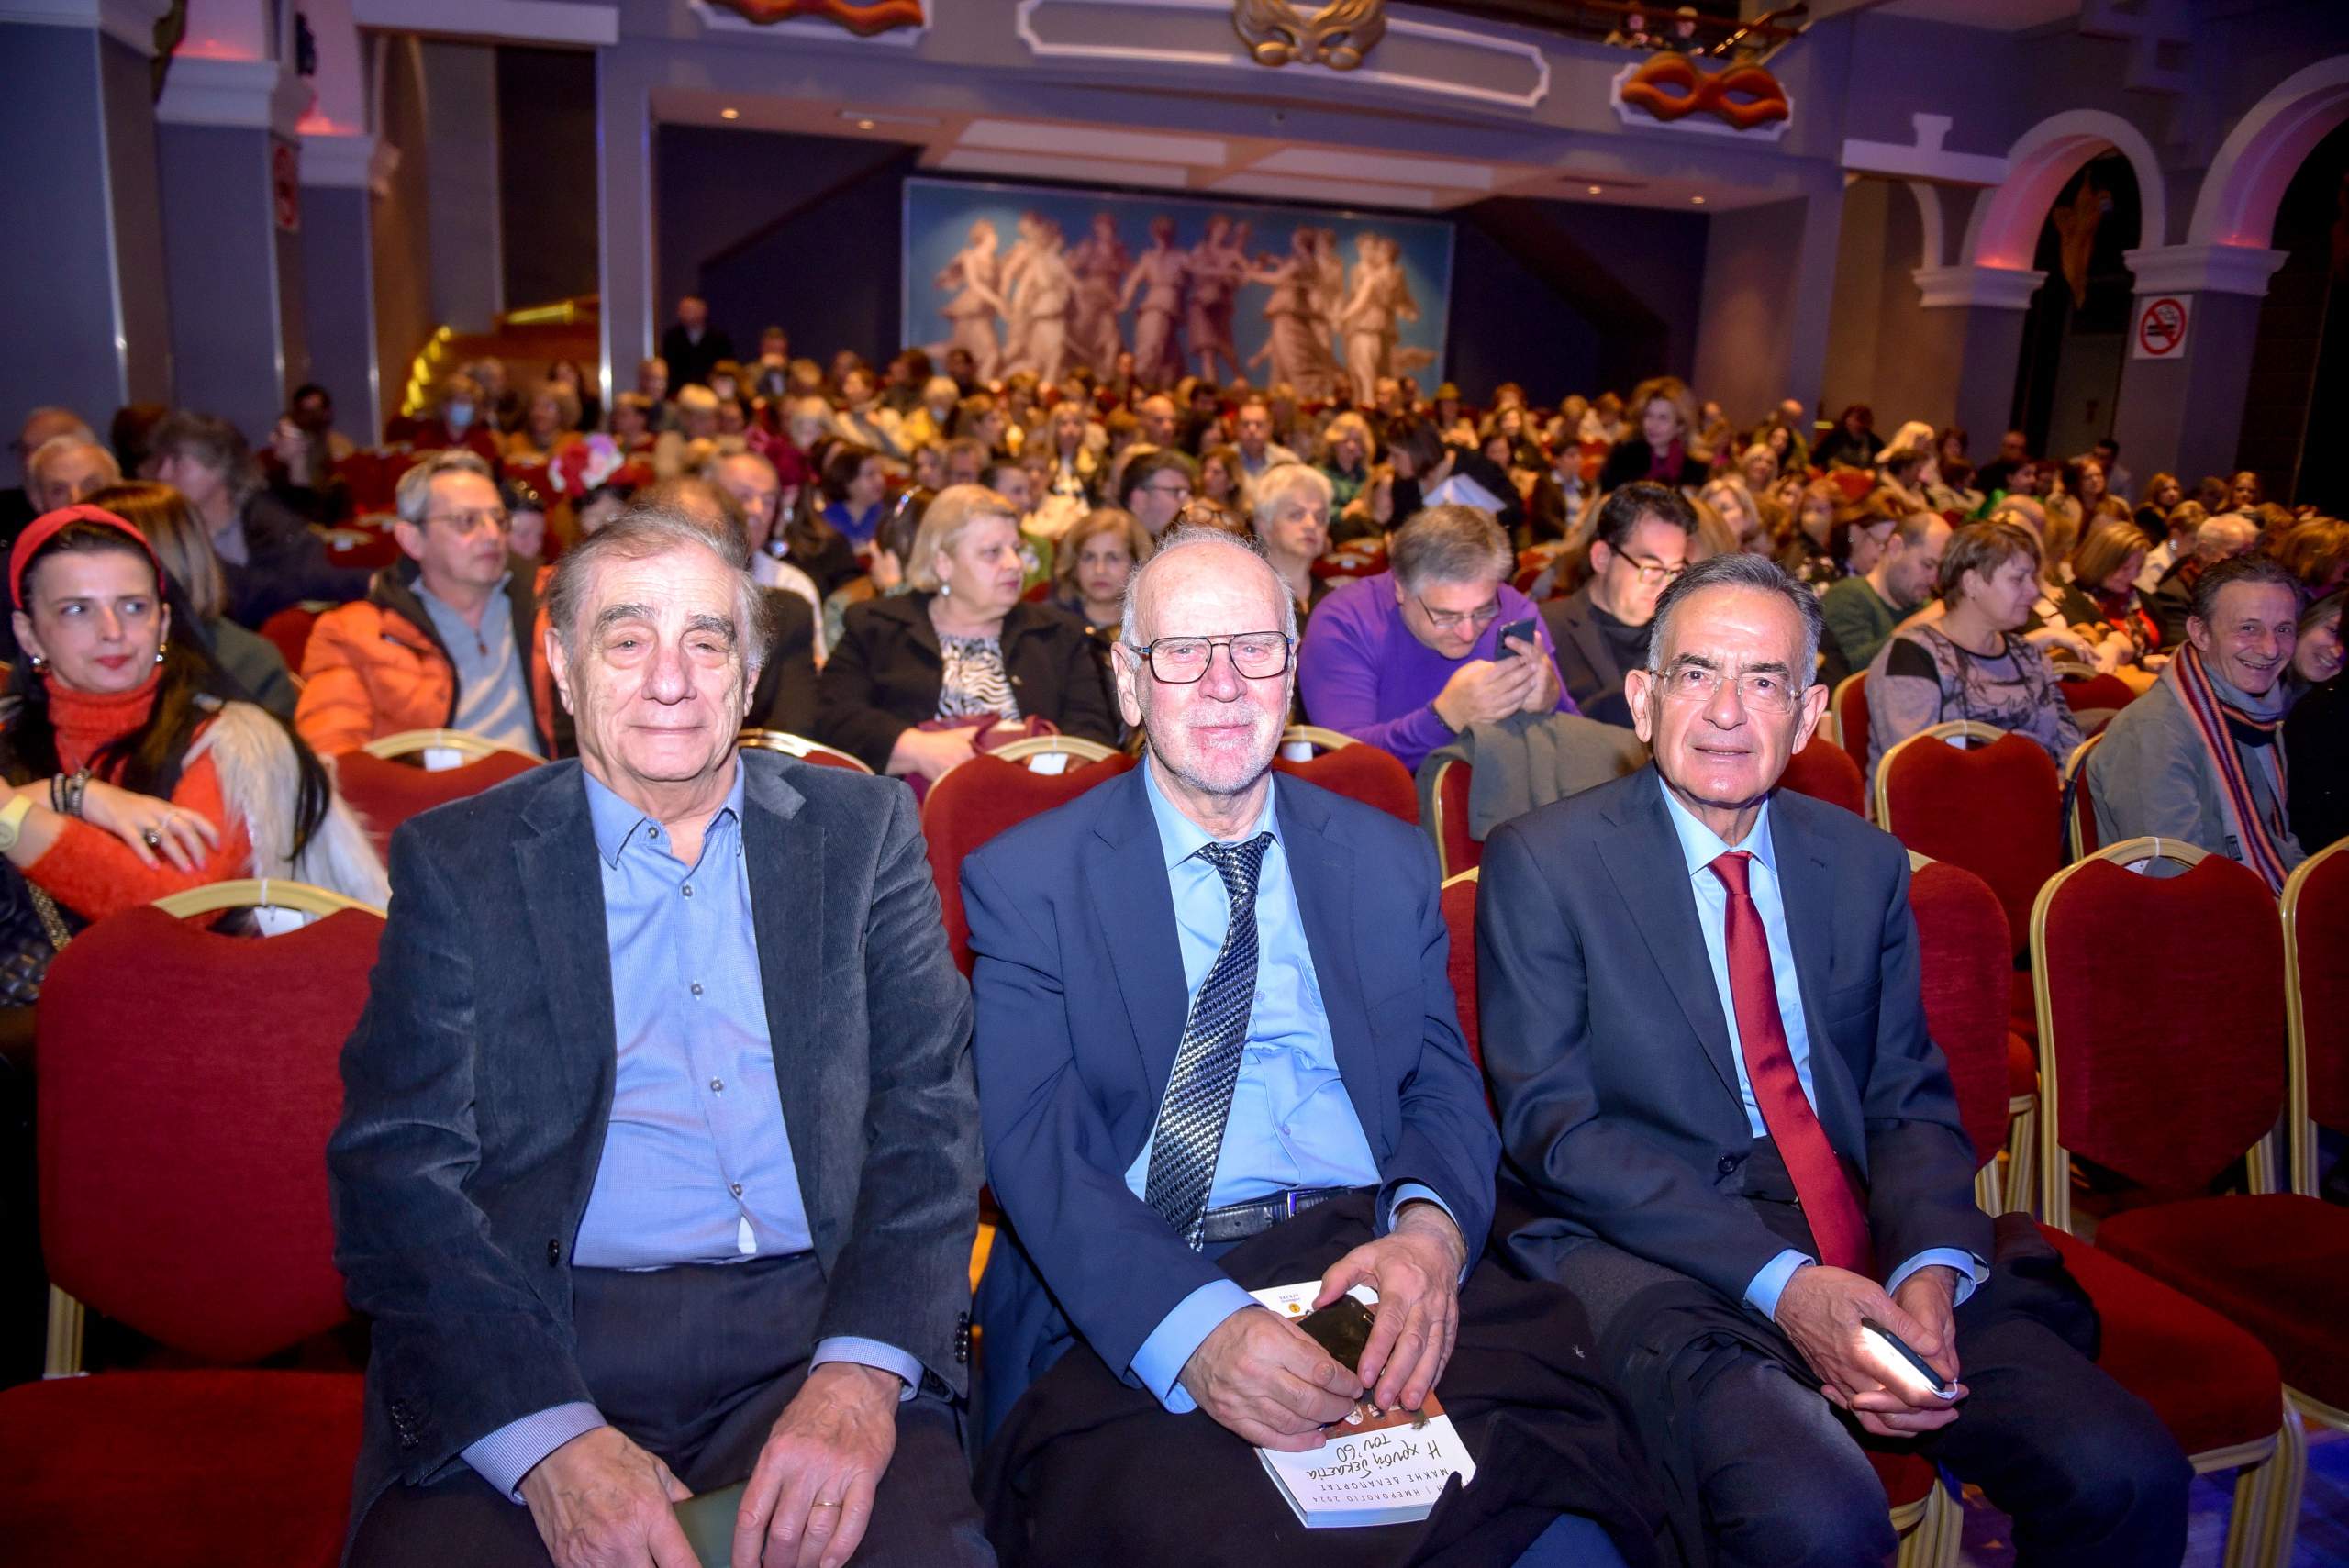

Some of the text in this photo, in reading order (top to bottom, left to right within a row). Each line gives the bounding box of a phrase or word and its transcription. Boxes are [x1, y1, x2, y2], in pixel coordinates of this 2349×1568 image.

[1364, 1433, 1391, 1451] του
[1373, 1440, 1419, 1469] χρυσή
[1307, 1459, 1372, 1480] δεκαετία
[1318, 1468, 1449, 1490] ΜΑΚΗΣ ΔΕΛΑΠΟΡΤΑΣ
[1346, 1489, 1419, 1502] ΗΜΕΡΟΛΟΓΙΟ
